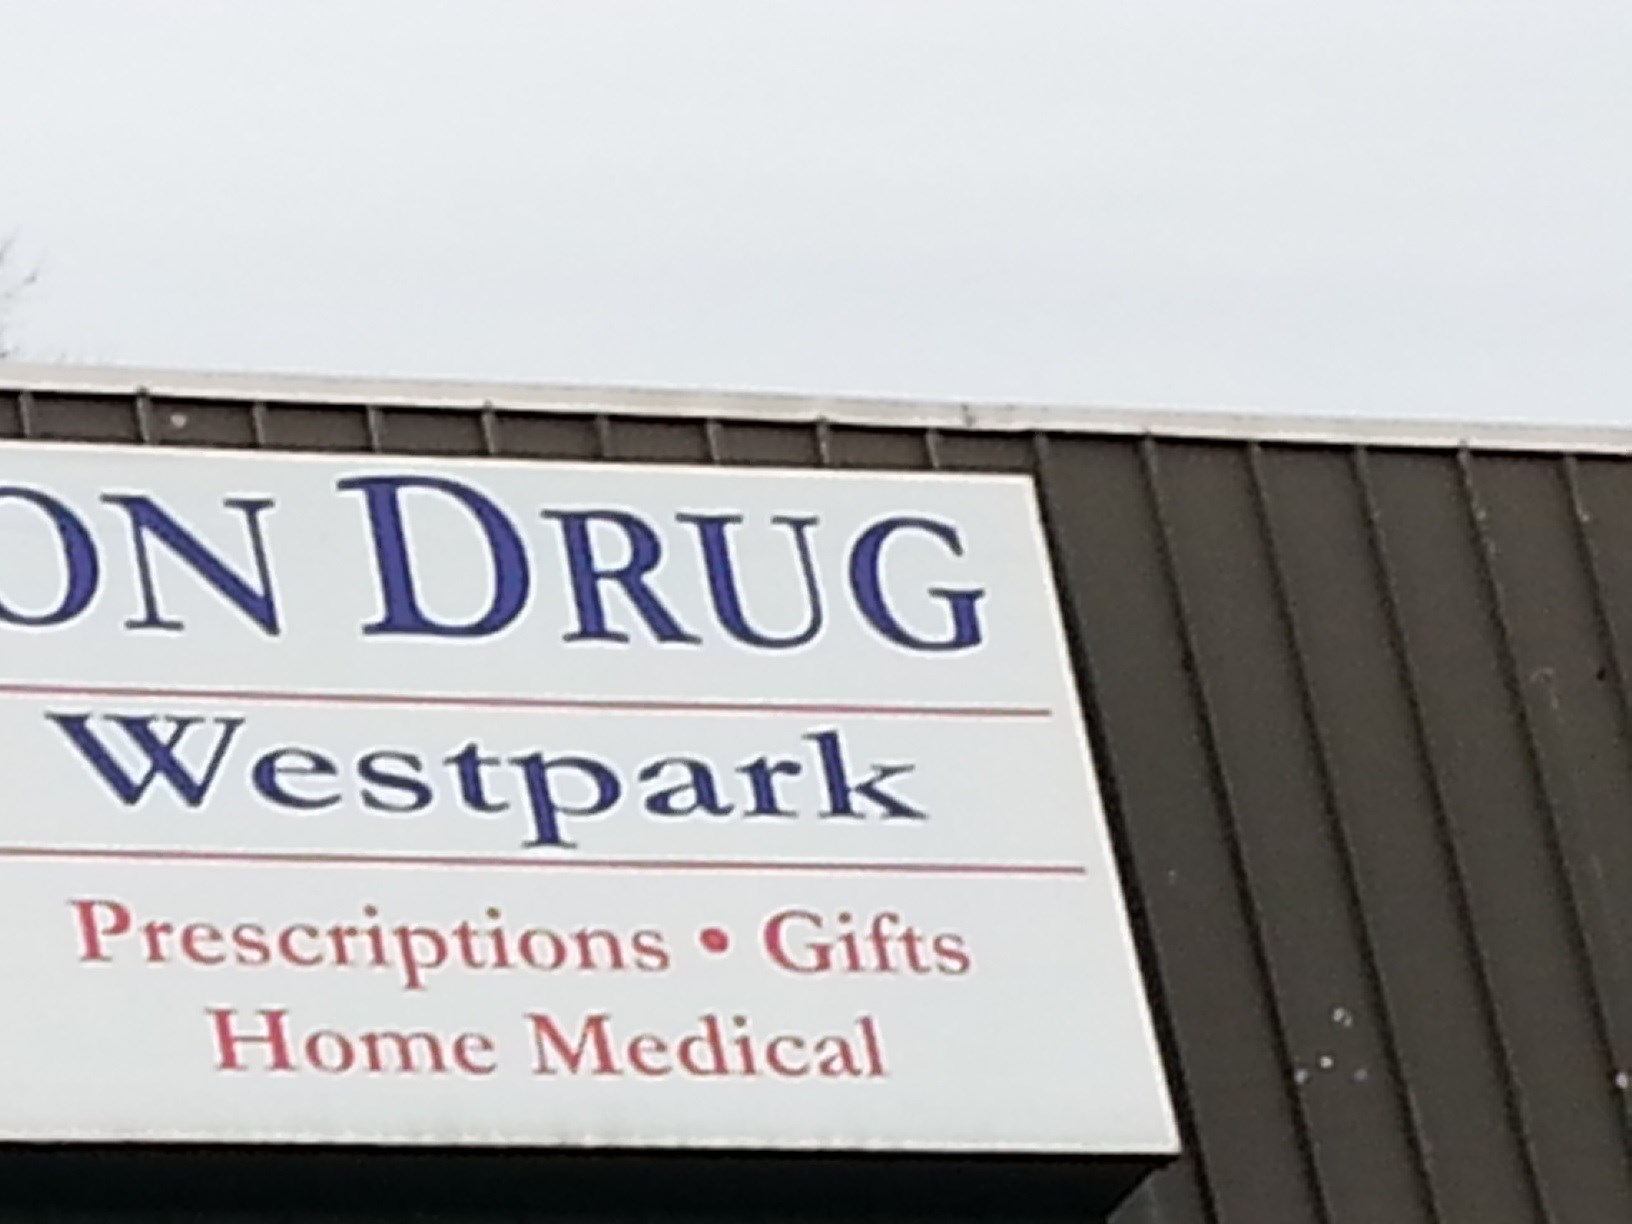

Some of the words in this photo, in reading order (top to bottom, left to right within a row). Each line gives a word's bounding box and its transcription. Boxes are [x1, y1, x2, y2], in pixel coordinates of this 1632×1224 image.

[337, 474, 985, 652] DRUG
[46, 711, 928, 848] Westpark
[75, 899, 670, 990] Prescriptions
[764, 908, 970, 976] Gifts
[207, 1008, 498, 1075] Home
[526, 1013, 889, 1078] Medical
